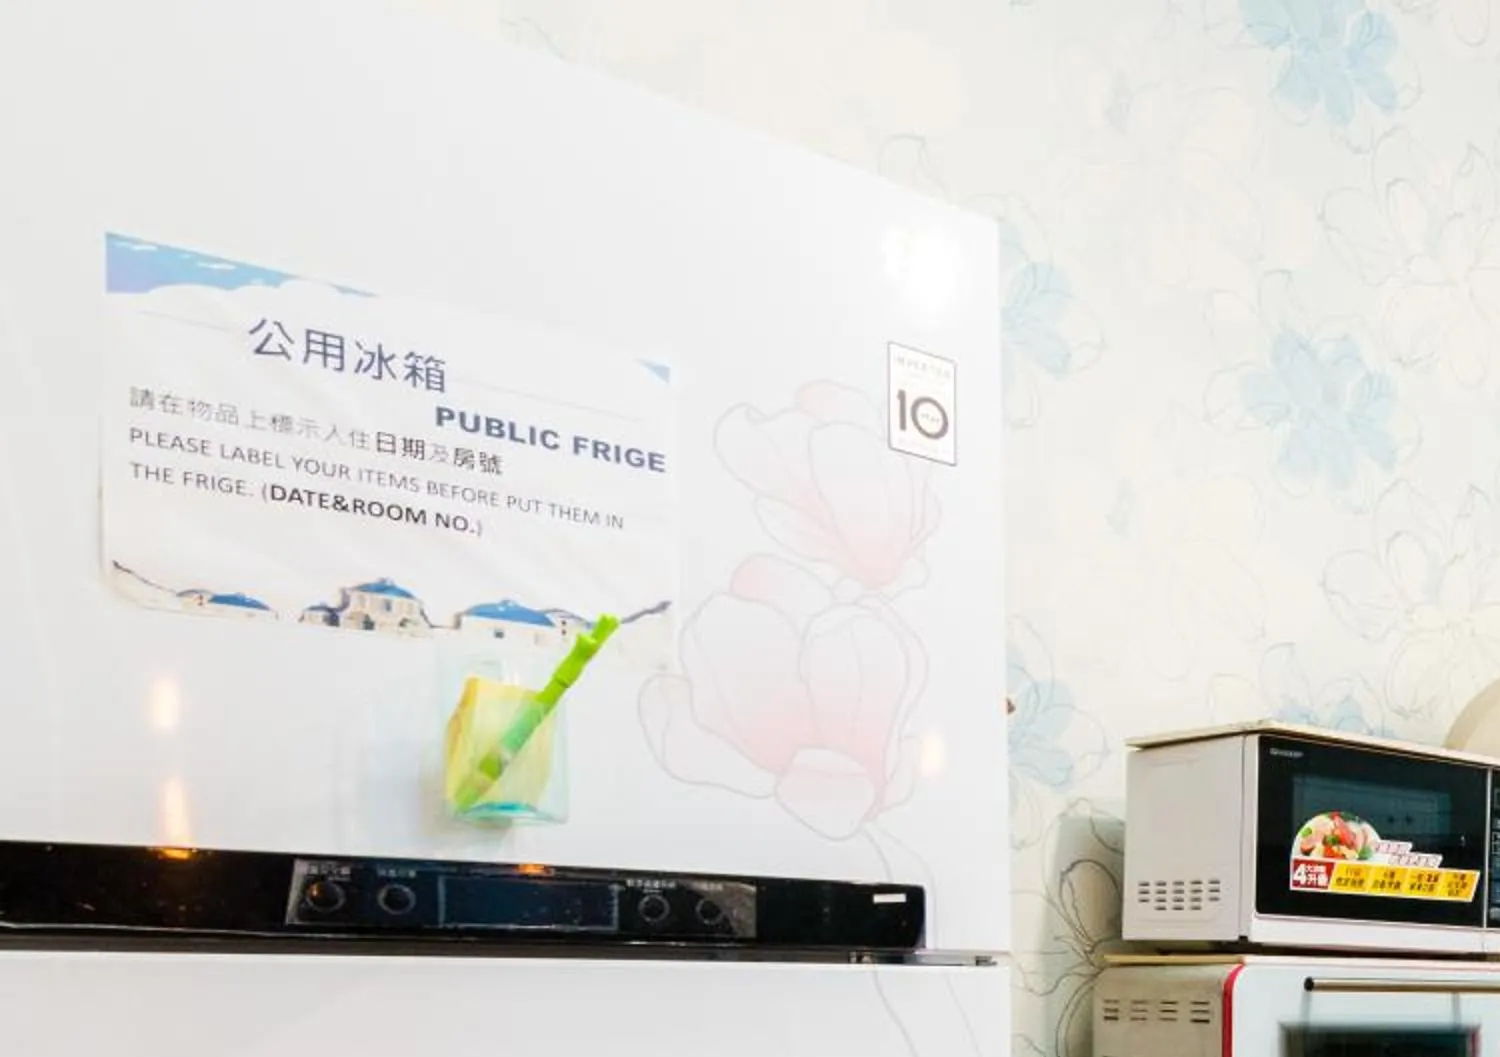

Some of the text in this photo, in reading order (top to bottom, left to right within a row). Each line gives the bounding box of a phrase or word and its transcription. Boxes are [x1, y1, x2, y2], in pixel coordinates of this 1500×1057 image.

[248, 317, 446, 393] 公用冰箱
[435, 406, 667, 474] PUBLIC FRIGE
[896, 389, 949, 440] 10
[129, 428, 624, 530] PLEASE LABEL YOUR ITEMS BEFORE PUT THEM IN
[129, 462, 484, 537] THE FRIGE. (DATE&ROOM NO.)
